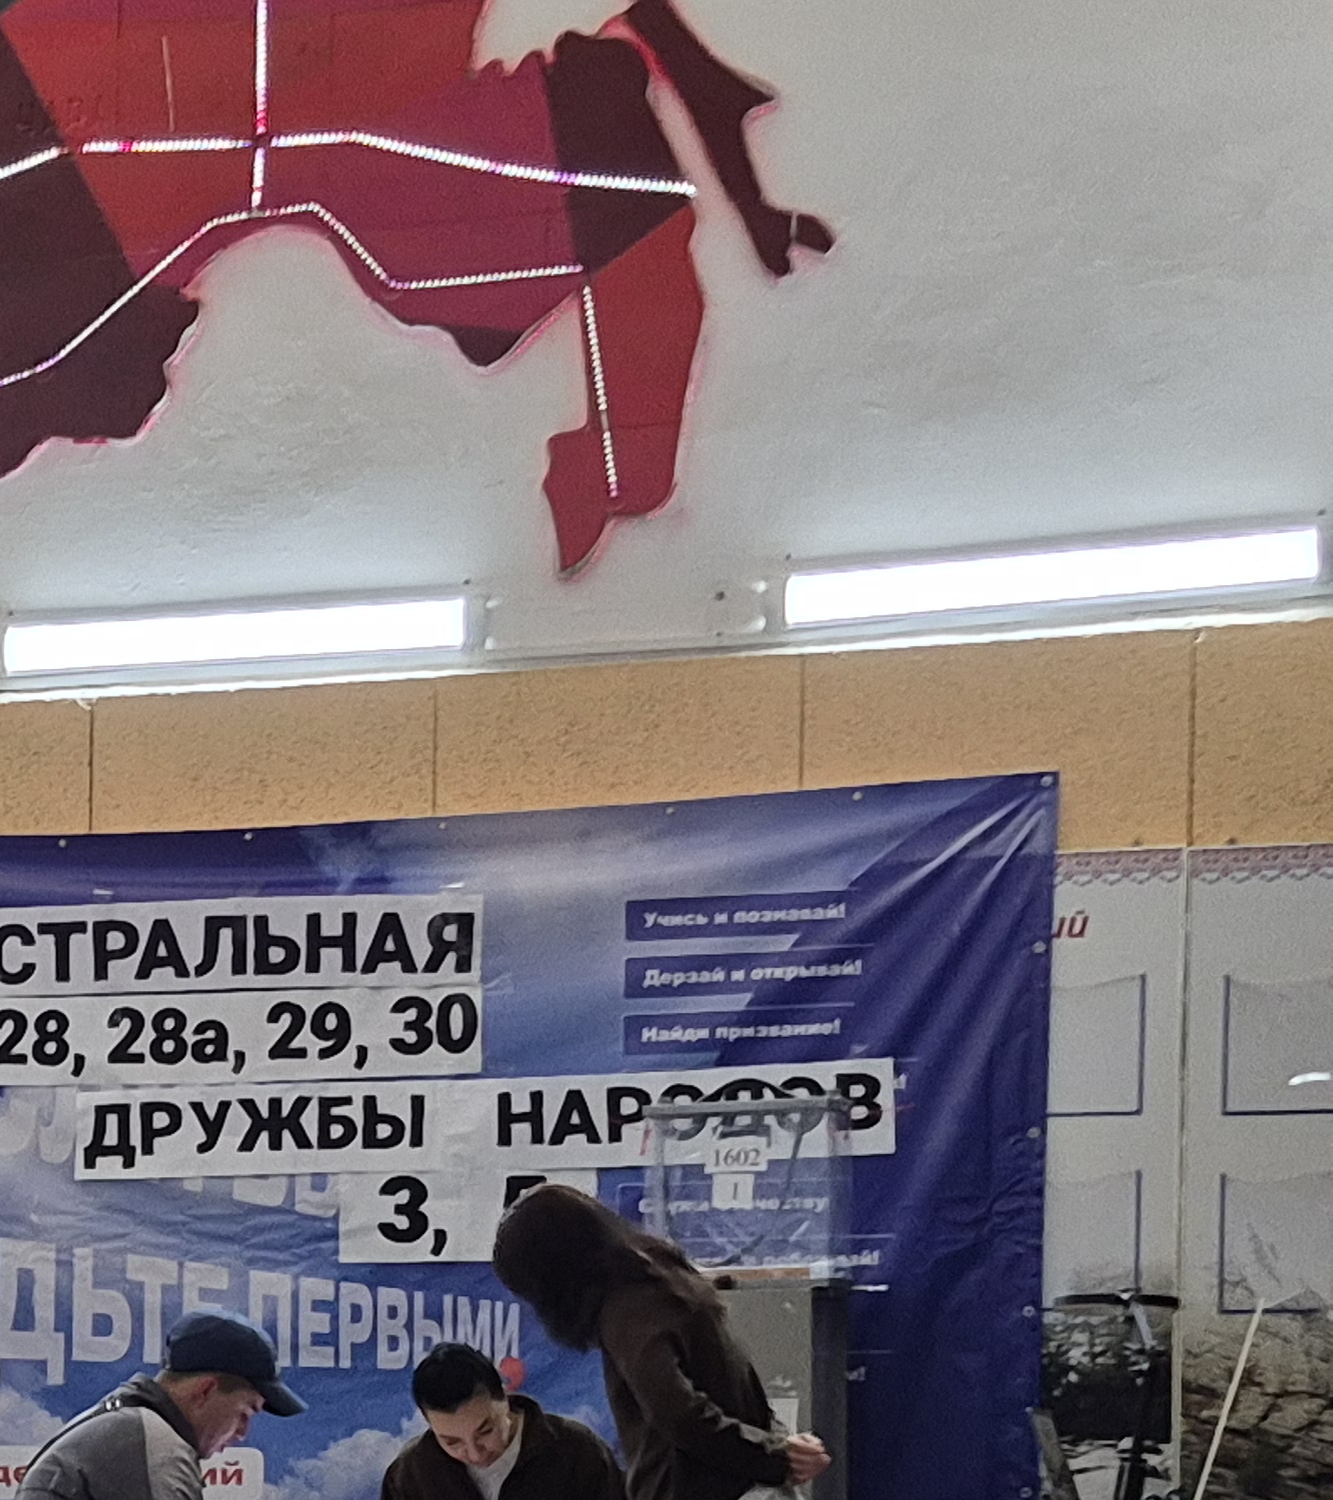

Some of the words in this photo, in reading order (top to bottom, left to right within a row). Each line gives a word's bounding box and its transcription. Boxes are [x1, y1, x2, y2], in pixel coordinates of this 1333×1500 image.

[643, 911, 708, 928] Учись
[714, 911, 728, 925] и
[733, 903, 846, 925] познавай!
[643, 967, 725, 988] Дерзай
[731, 969, 745, 982] и
[750, 959, 863, 982] открывай!
[107, 1007, 246, 1074] 28а,
[266, 1001, 370, 1069] 29,
[388, 994, 478, 1056] 30
[641, 1024, 710, 1042] Найди
[83, 1095, 426, 1170] ДРУЖБЫ
[713, 1148, 762, 1167] 1602
[377, 1175, 448, 1255] 3,
[247, 1270, 521, 1371] ПЕРВЫМИ
